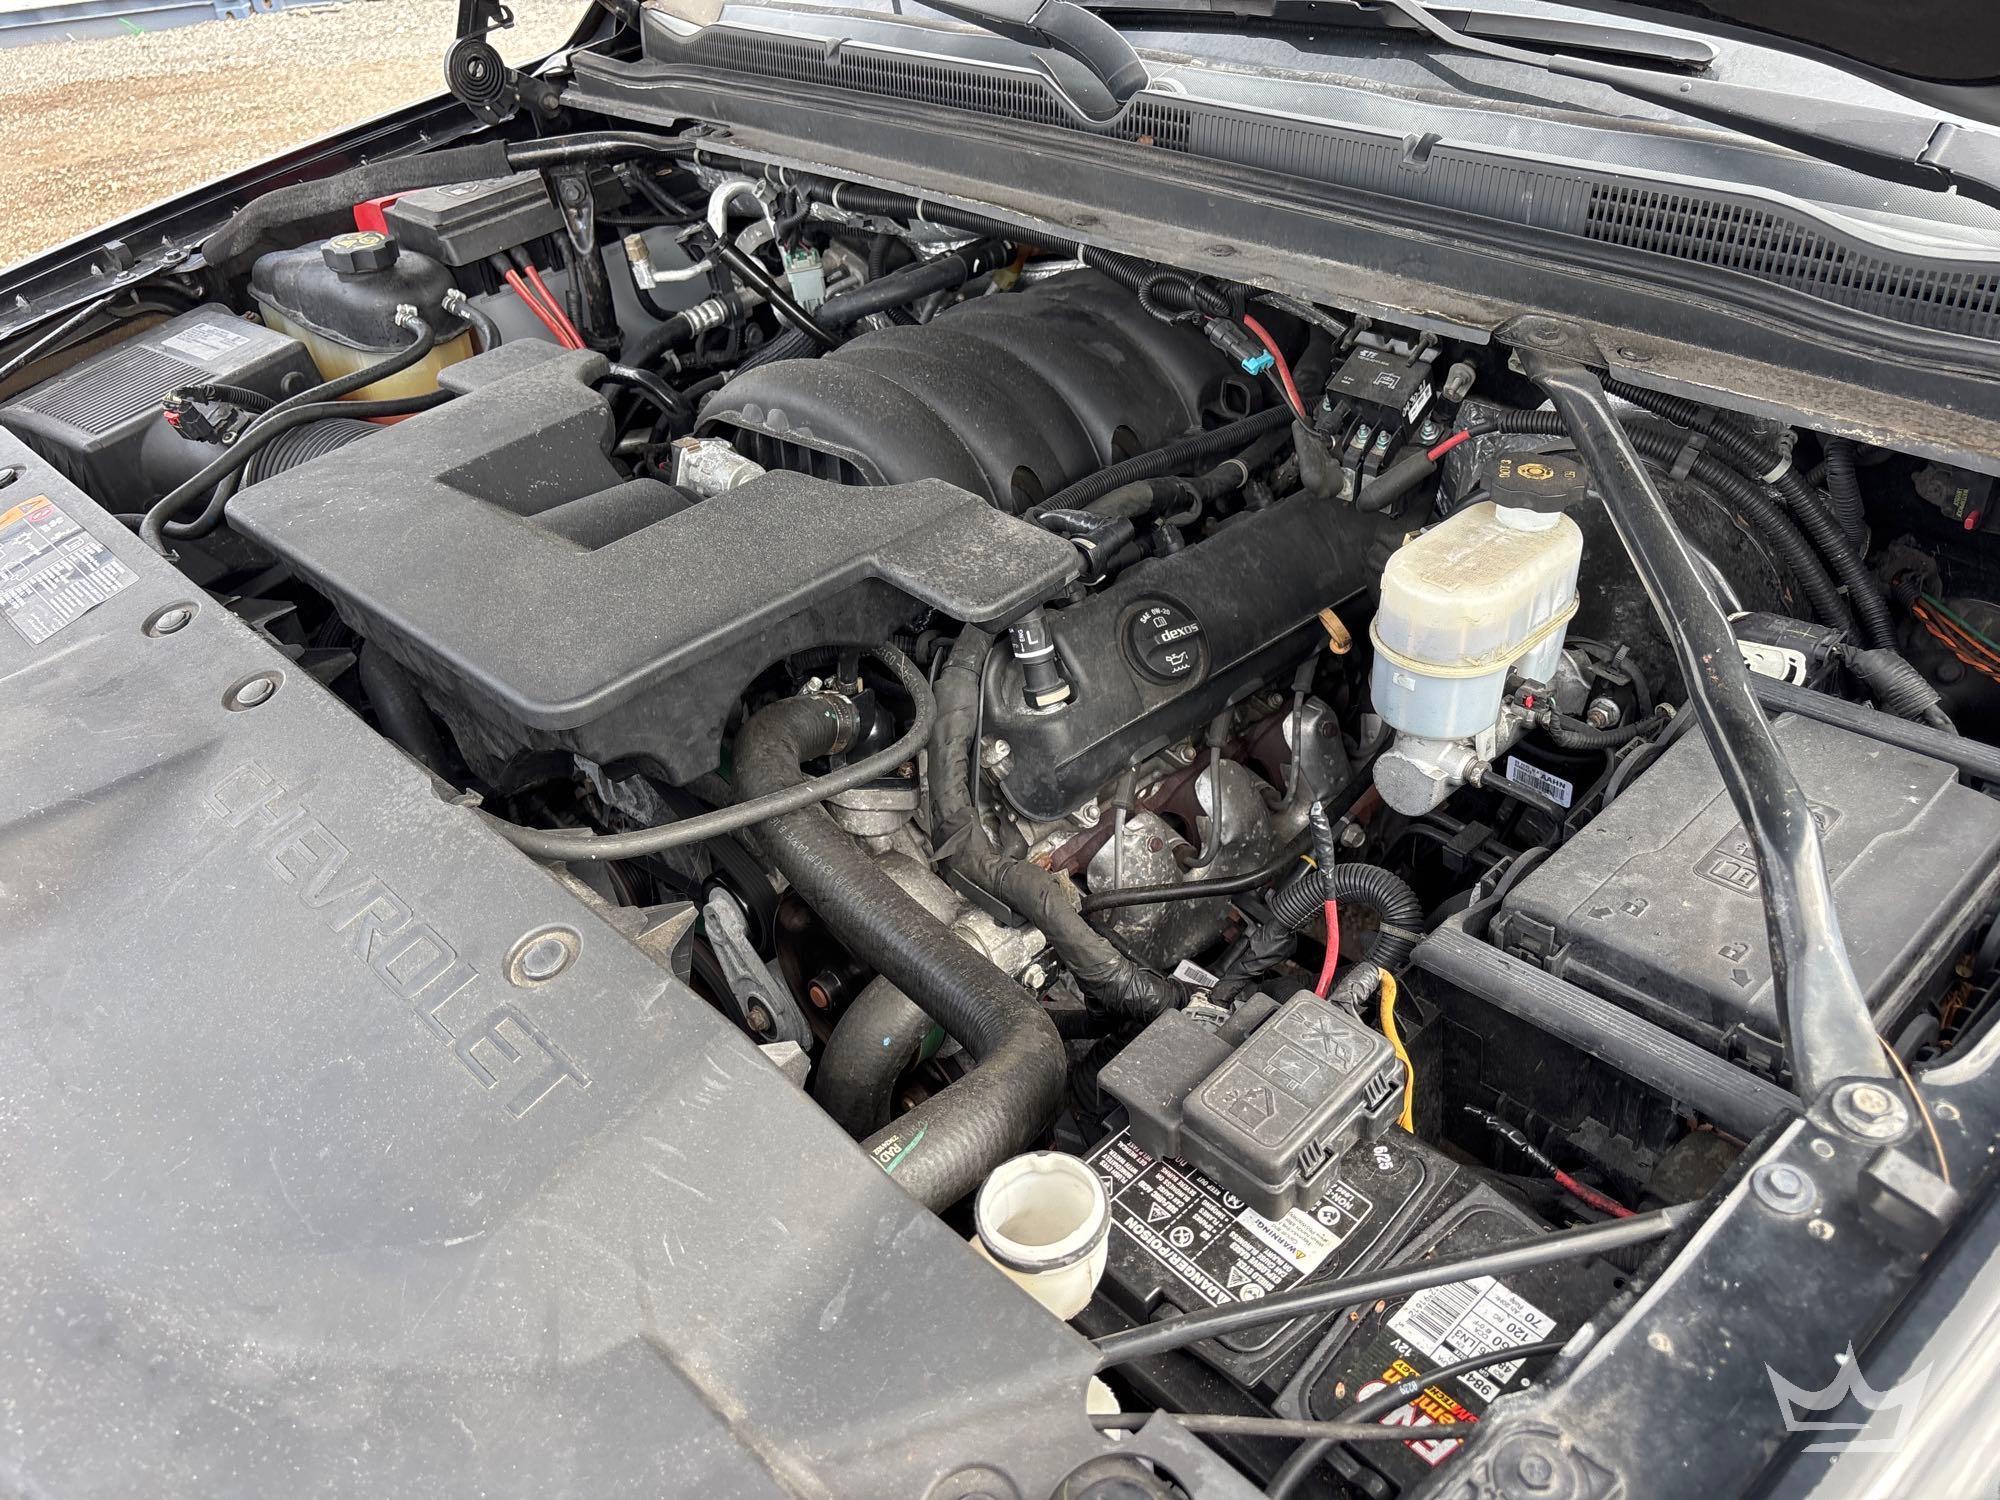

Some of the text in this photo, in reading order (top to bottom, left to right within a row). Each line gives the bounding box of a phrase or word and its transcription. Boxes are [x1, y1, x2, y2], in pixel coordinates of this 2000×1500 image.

[1140, 612, 1152, 624] SAE
[1026, 630, 1038, 645] L
[1161, 623, 1199, 642] dexos
[1540, 774, 1566, 789] AAHN
[204, 759, 593, 1119] CHEVROLET
[880, 1143, 902, 1162] RAD
[1117, 1141, 1146, 1166] GET MEDICAL
[1138, 1150, 1152, 1161] HELP
[1374, 1146, 1394, 1170] 6/25
[1099, 1160, 1127, 1183] FLUSH EYES
[1101, 1153, 1132, 1178] IMMEDIATELY
[1124, 1162, 1137, 1173] WITH
[1155, 1172, 1164, 1180] OR
[1197, 1176, 1208, 1185] OUT
[1138, 1180, 1178, 1213] SULFURIC ACID
[1156, 1184, 1184, 1207] CAN CAUSE
[1163, 1179, 1190, 1202] BLINDNESS
[1177, 1179, 1196, 1196] SEVERE
[1207, 1183, 1220, 1195] KEEP
[1198, 1207, 1219, 1224] FLAMES
[1201, 1199, 1225, 1219] SMOKING
[1192, 1213, 1213, 1231] SPARKS
[1200, 1231, 1211, 1240] NO
[1124, 1217, 1220, 1298] DANGER/POISON
[1229, 1230, 1287, 1277] CAN CAUSE BLINDNESS
[1229, 1241, 1281, 1283] EXPLOSIVE GASES
[1282, 1263, 1292, 1272] OR
[1251, 1272, 1274, 1290] SHIELD
[1524, 1312, 1542, 1329] 70
[1454, 1330, 1475, 1347] LN3
[1506, 1323, 1529, 1343] 120
[1390, 1338, 1412, 1357] 12V
